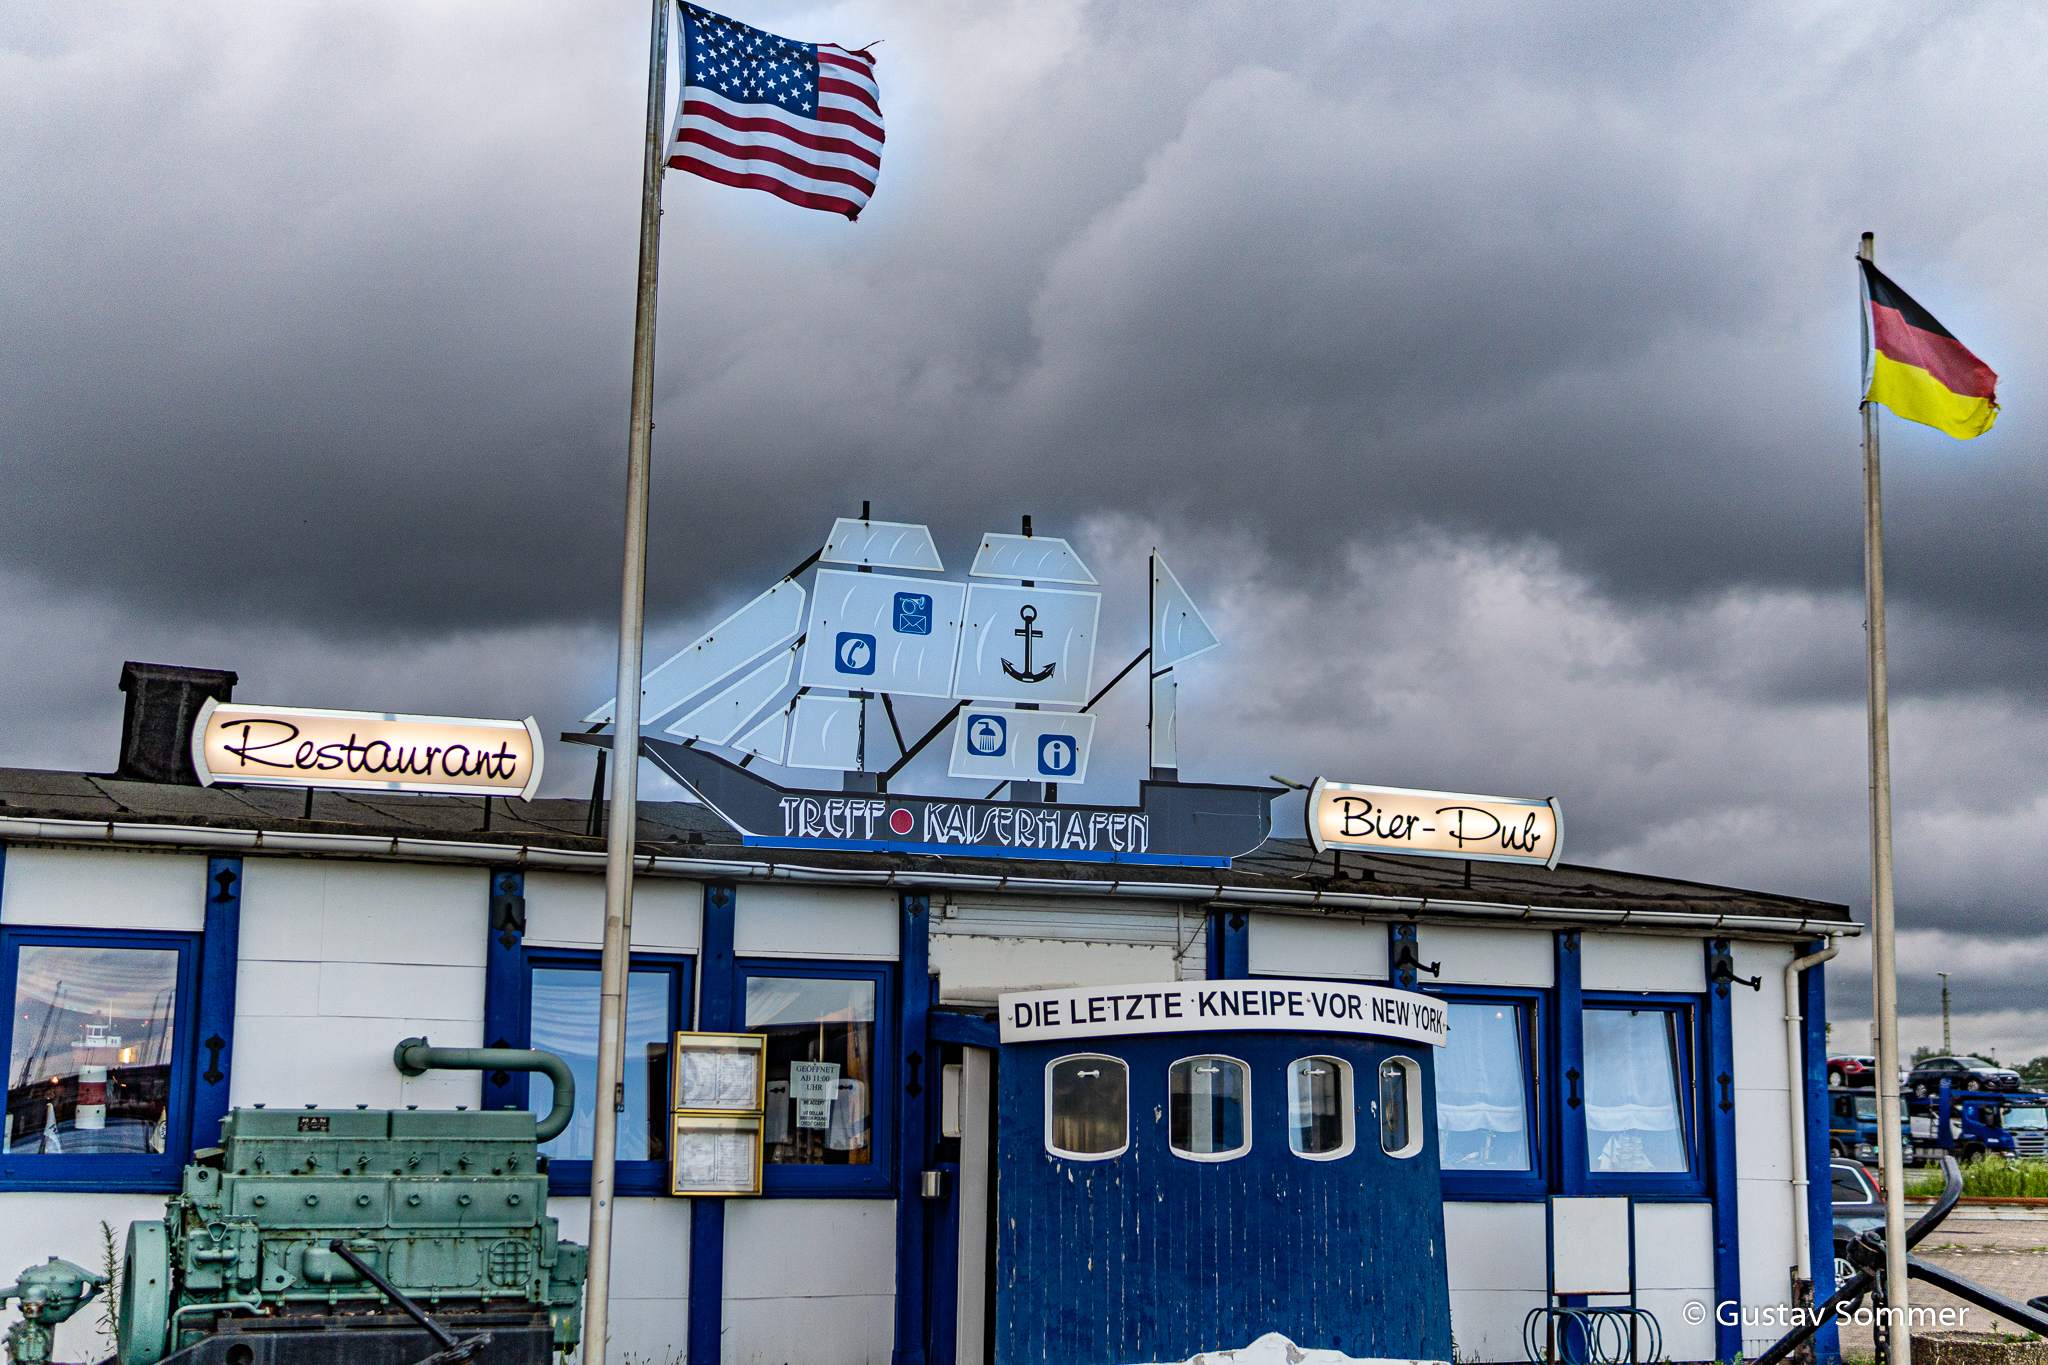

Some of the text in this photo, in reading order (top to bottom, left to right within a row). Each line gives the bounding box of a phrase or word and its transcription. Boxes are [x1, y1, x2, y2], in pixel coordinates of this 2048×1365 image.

[221, 719, 516, 779] Restaurant
[778, 796, 1149, 852] TREFF KAISERHAFEN
[1014, 990, 1443, 1035] DIE LETZTE KNEIPE VOR NEW YORK
[796, 1065, 835, 1073] GEÖFFNET
